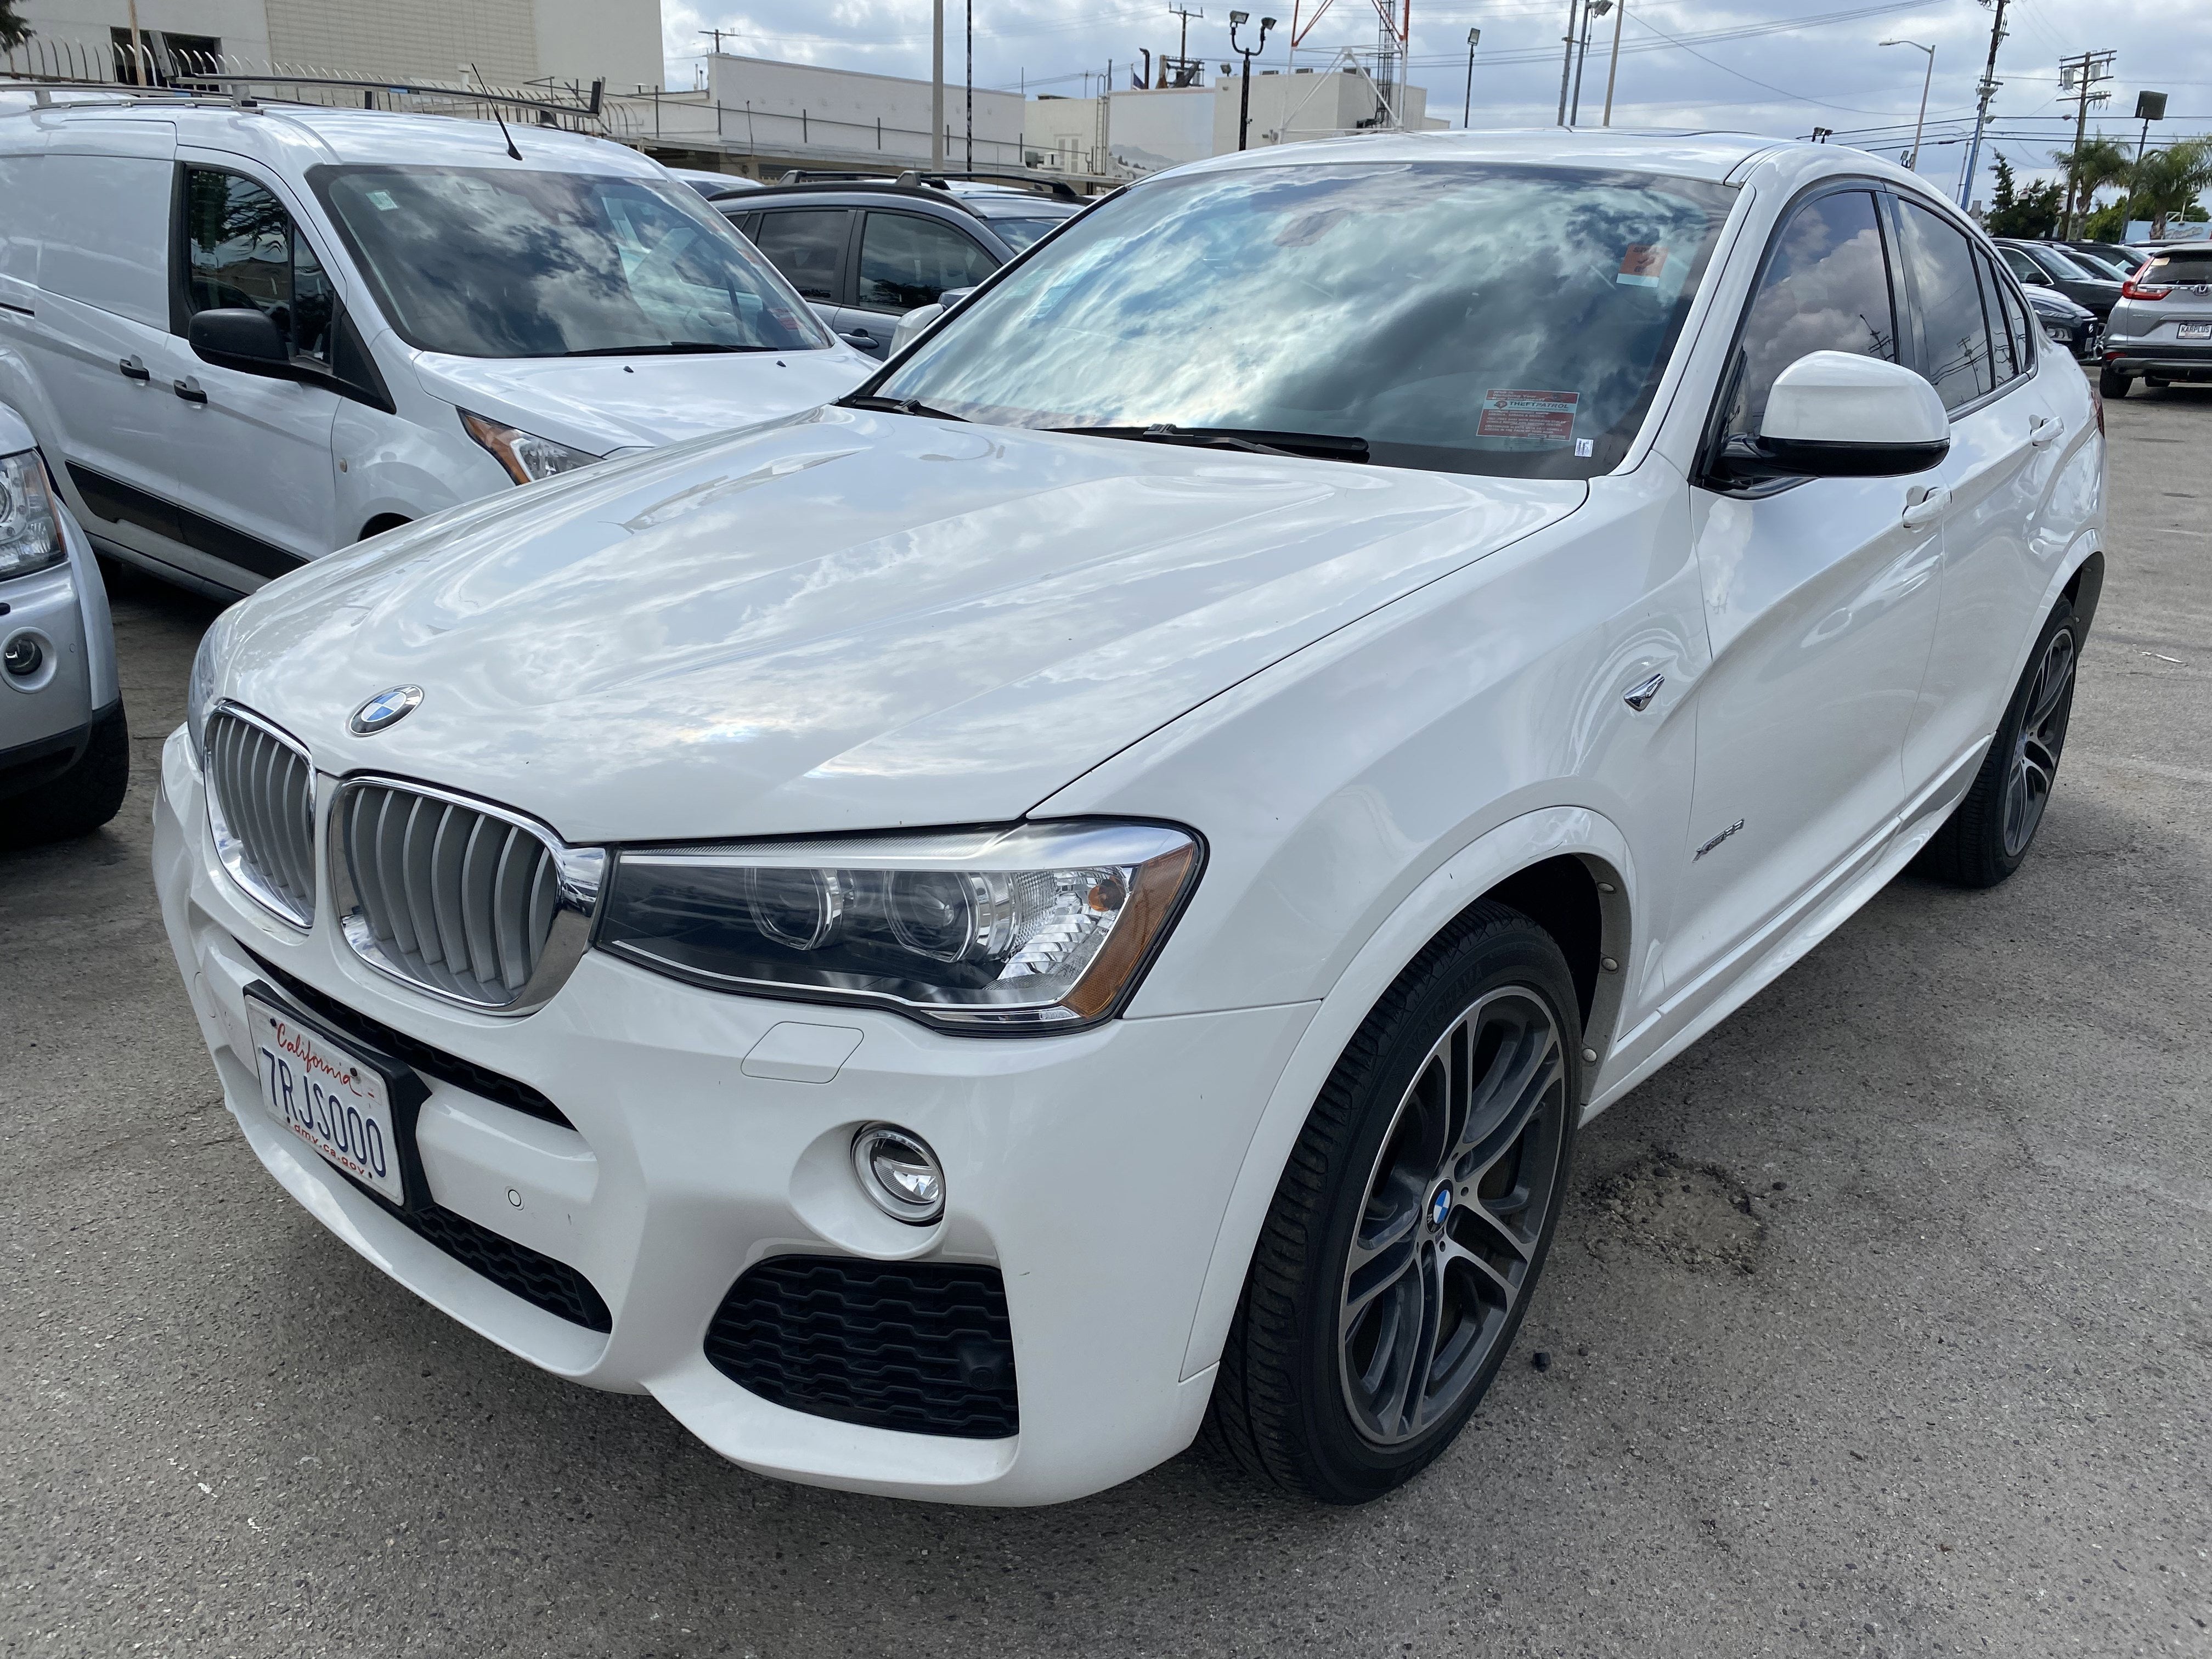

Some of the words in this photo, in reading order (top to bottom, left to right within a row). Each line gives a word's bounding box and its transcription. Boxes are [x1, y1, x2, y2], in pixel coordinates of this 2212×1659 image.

[277, 1023, 362, 1097] California
[262, 1046, 386, 1178] 7RJS000
[294, 1123, 364, 1175] dmv.ca.gov
